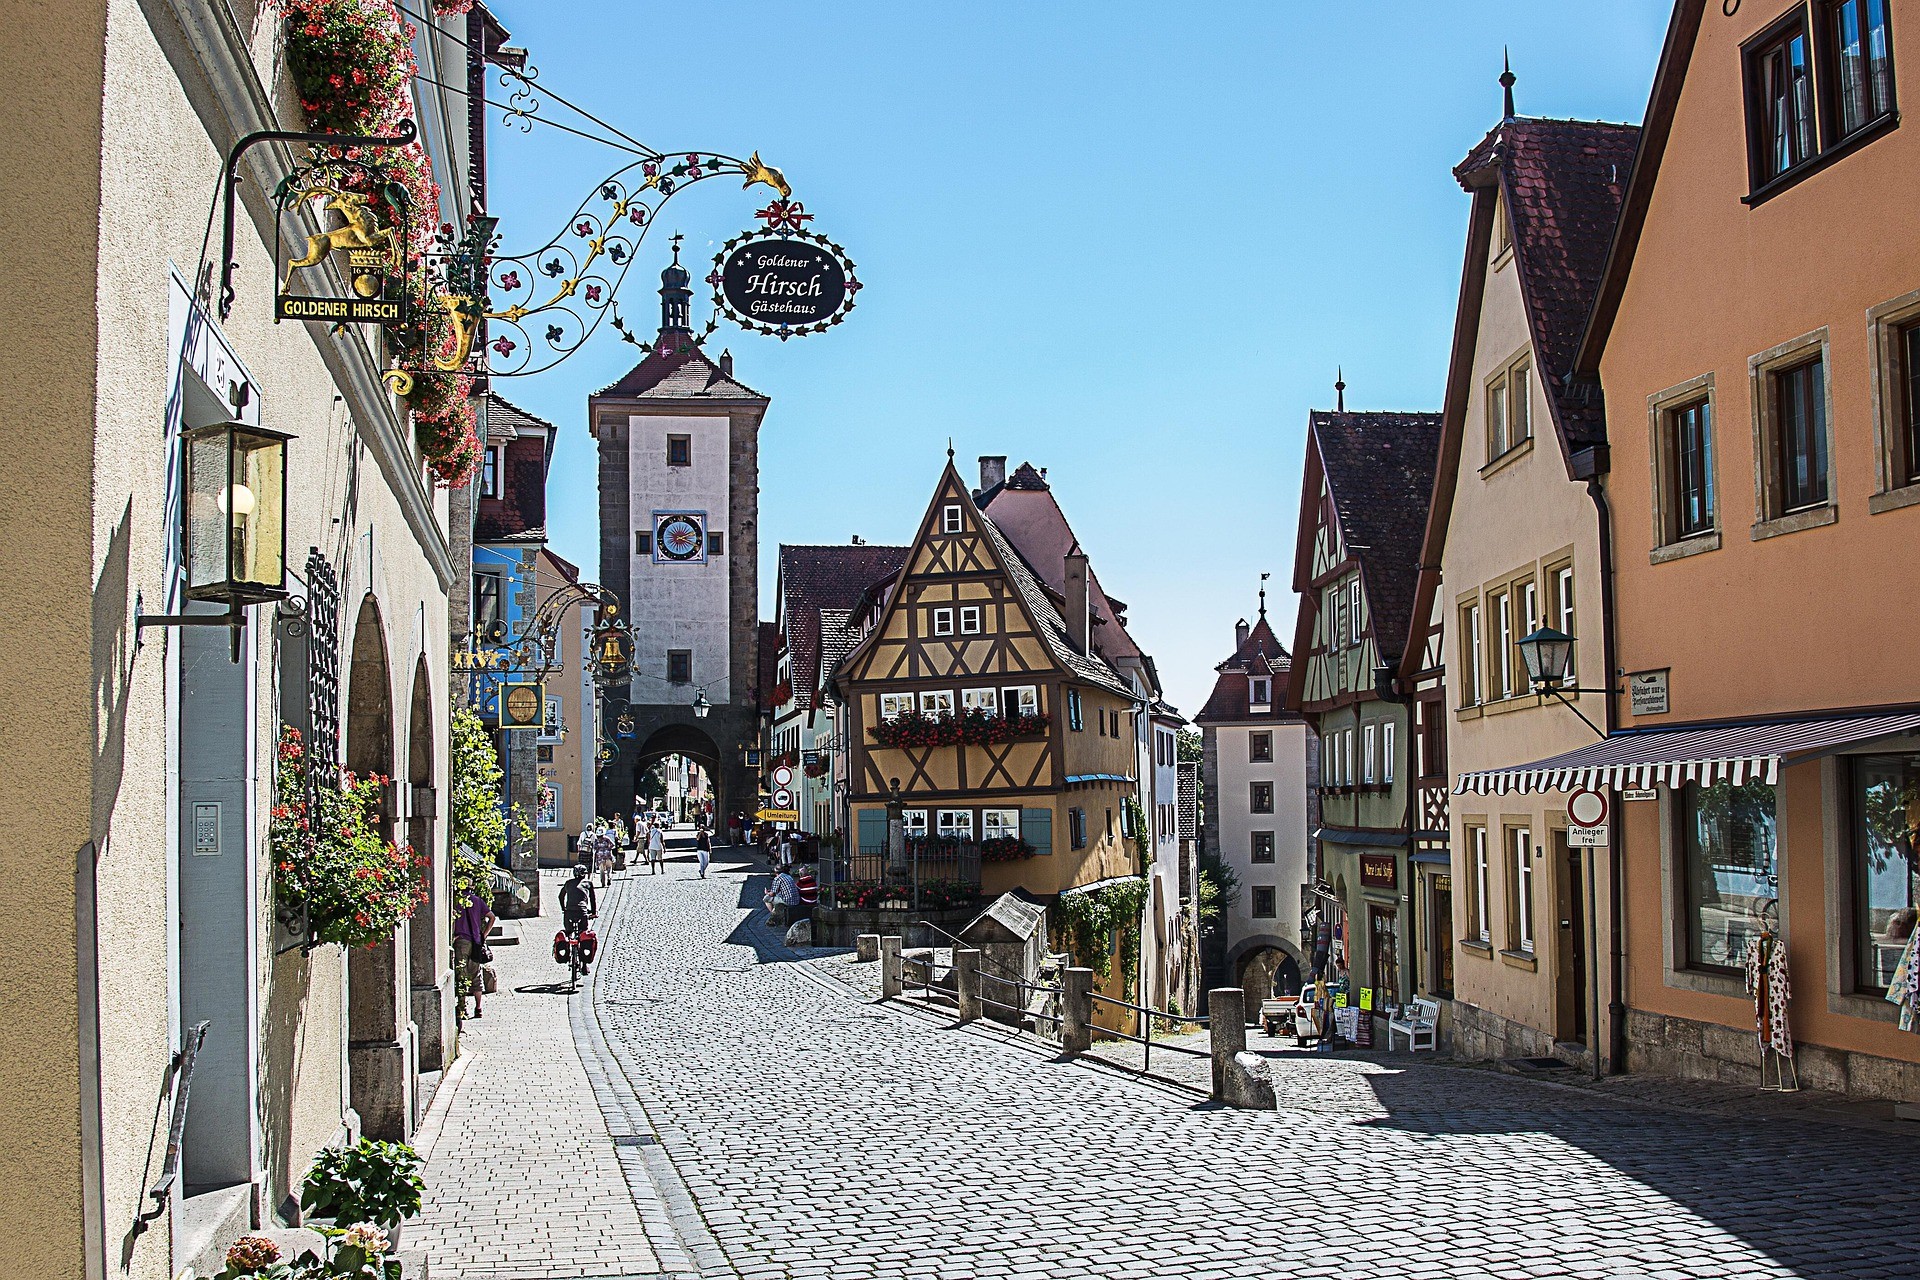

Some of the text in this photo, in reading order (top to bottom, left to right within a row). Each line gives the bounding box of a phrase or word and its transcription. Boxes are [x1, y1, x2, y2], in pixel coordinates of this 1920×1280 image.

[757, 254, 810, 269] Goldener
[744, 272, 823, 297] Hirsch
[284, 300, 398, 318] GOLDENER HIRSCH
[750, 300, 817, 315] Gästehaus
[767, 812, 797, 820] Umleitung
[1572, 828, 1604, 836] Anlieger
